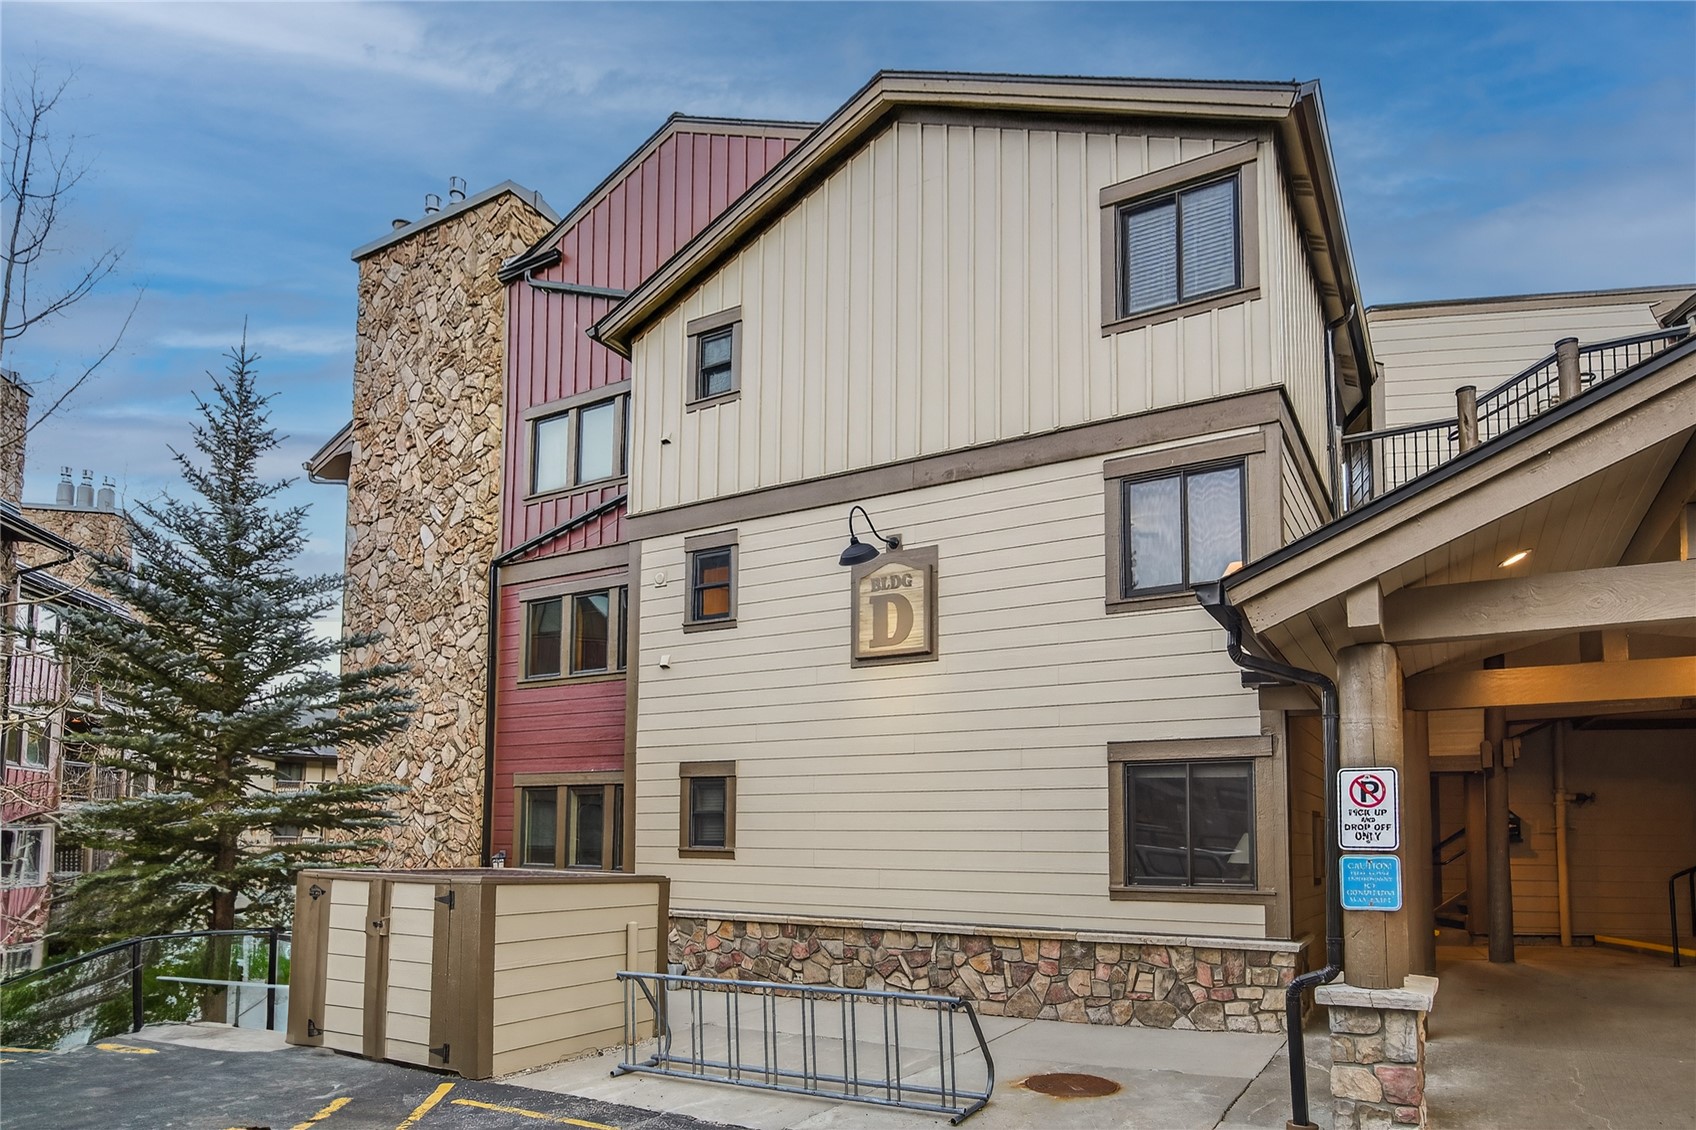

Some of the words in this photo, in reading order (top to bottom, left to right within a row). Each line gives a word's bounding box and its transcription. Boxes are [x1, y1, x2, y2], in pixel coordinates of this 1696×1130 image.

[871, 573, 913, 592] BLDG
[869, 593, 914, 648] D
[1344, 823, 1371, 831] DROP
[1374, 823, 1392, 831] OFF
[1355, 832, 1381, 841] ONLY
